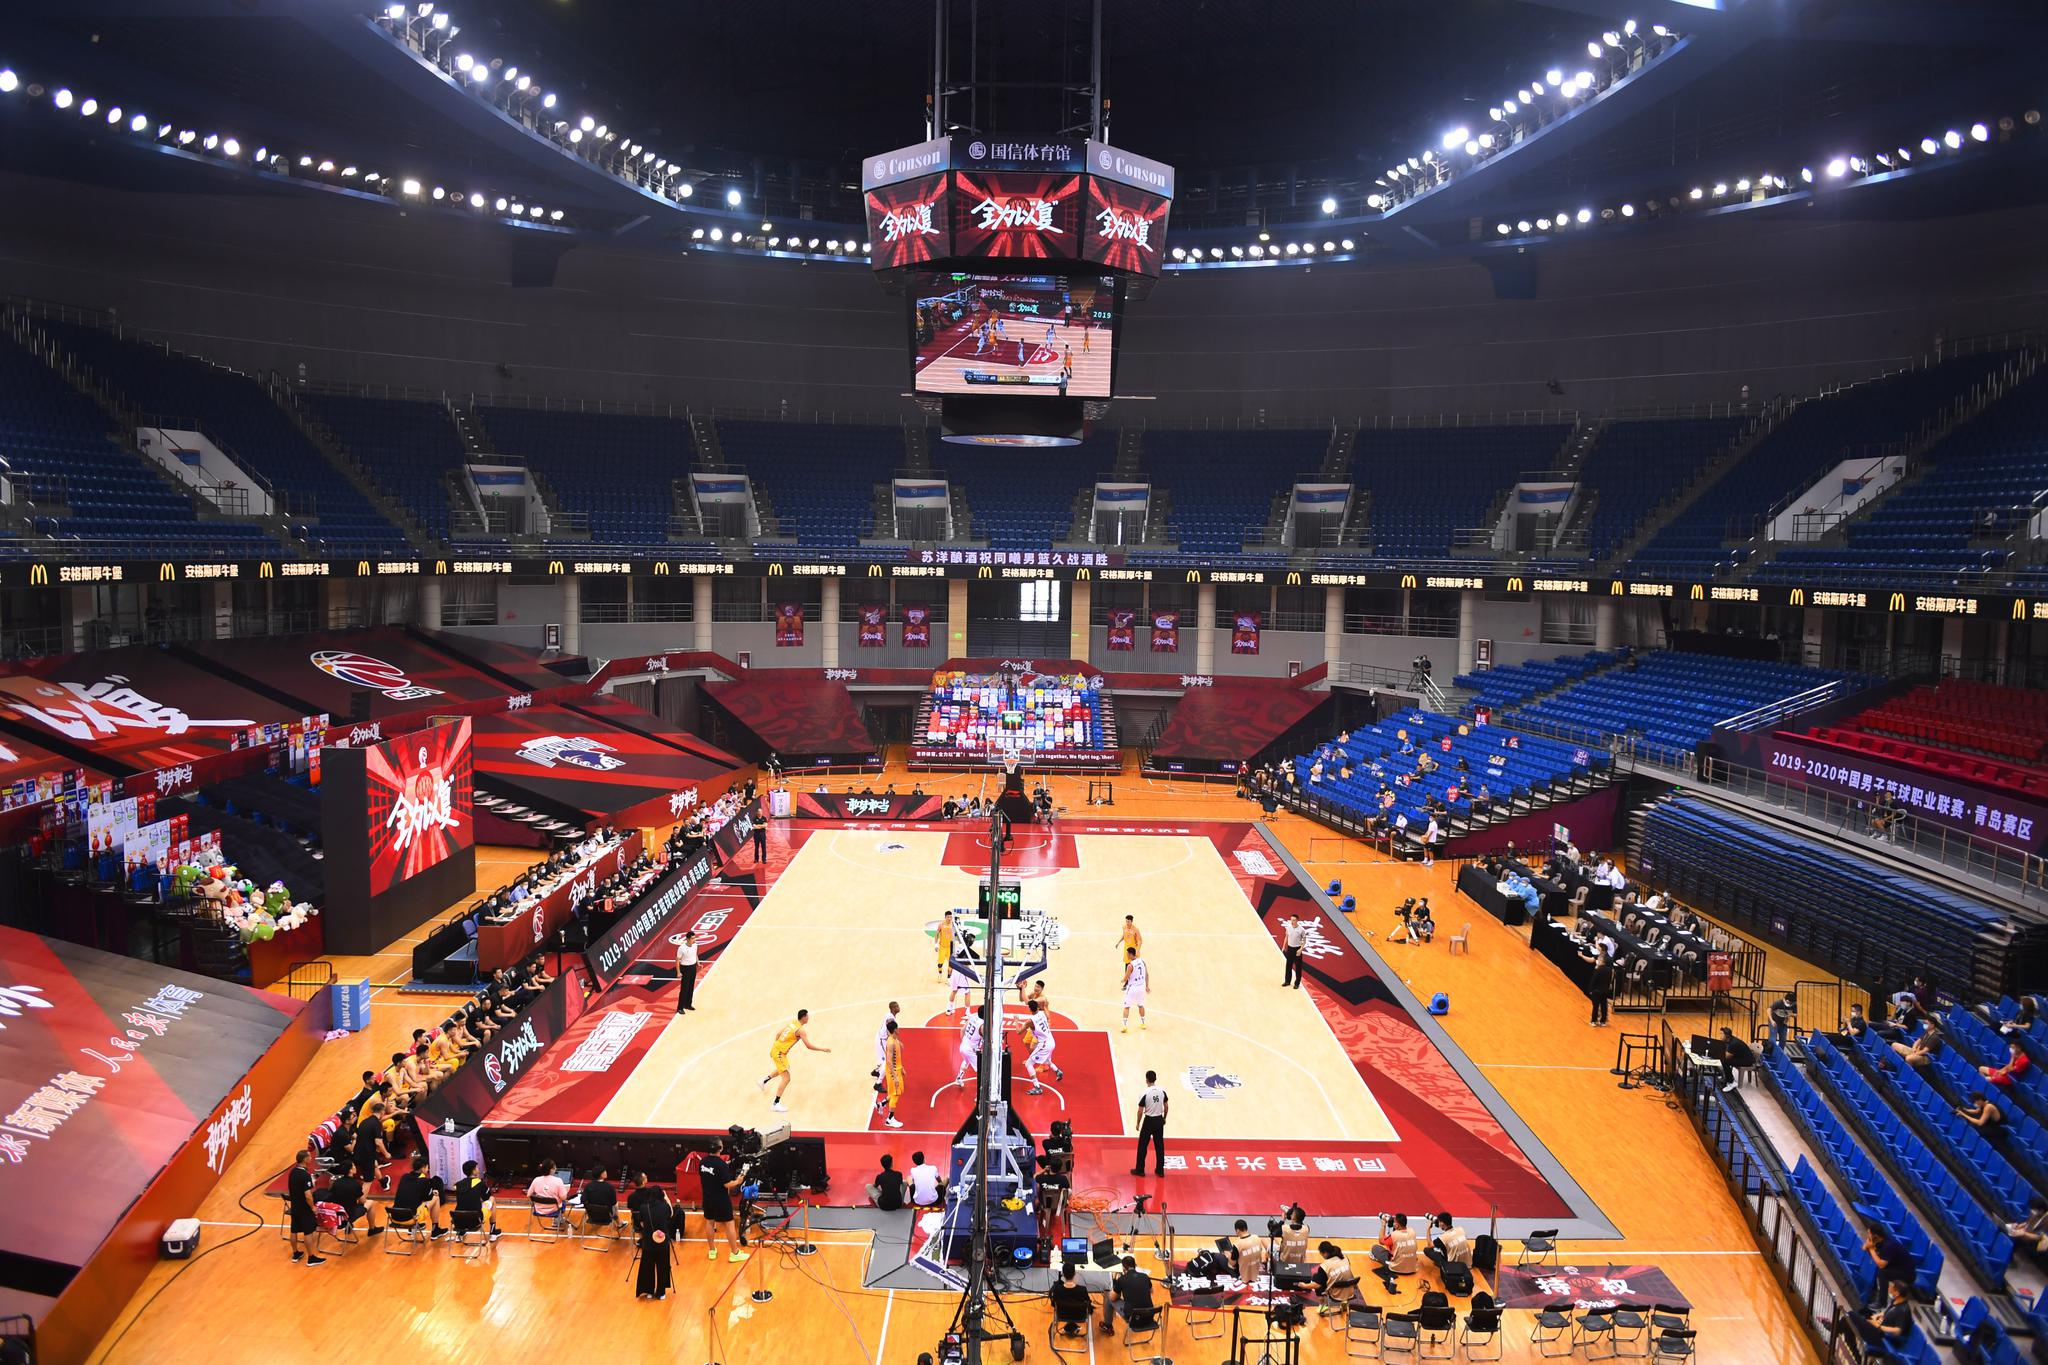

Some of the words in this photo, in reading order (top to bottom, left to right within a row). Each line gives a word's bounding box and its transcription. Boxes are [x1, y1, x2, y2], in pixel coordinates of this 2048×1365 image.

[991, 143, 1071, 162] 国信体育馆
[889, 149, 940, 175] Conson
[1115, 155, 1165, 187] Conson
[1093, 311, 1111, 319] 2019
[921, 551, 1108, 566] 苏洋酿酒祝同曦男篮久战酒胜
[59, 566, 122, 582] 安格斯厚牛堡
[185, 564, 238, 578] 安格斯厚牛堡
[282, 564, 329, 576] 安格斯厚牛堡
[377, 562, 419, 574] 安格斯厚牛堡
[453, 562, 512, 573] 安格斯厚牛堡
[574, 562, 631, 574] 安格斯厚牛堡
[679, 564, 734, 574] 安格斯厚牛堡
[792, 564, 846, 575] 安格斯厚牛堡
[892, 567, 945, 577] 安格斯厚牛堡
[1002, 568, 1054, 578] 安格斯厚牛堡
[1100, 570, 1152, 580] 安格斯厚牛堡
[1210, 572, 1264, 583] 安格斯厚牛堡
[1311, 574, 1366, 586] 安格斯厚牛堡
[1426, 577, 1483, 589] 安格斯厚牛堡
[1533, 580, 1588, 592] 安格斯厚牛堡
[1629, 583, 1673, 597] 安格斯厚牛堡
[1711, 587, 1758, 601] 安格斯厚牛堡
[1812, 592, 1866, 607] 安格斯厚牛堡
[1916, 597, 1977, 614] 安格斯厚牛堡
[154, 764, 193, 796] 敢梦敢当
[669, 787, 697, 818] 敢梦敢当
[845, 798, 890, 816] 敢梦敢当
[691, 906, 734, 933] CBA
[965, 1023, 976, 1036] 33
[5, 1071, 106, 1133] 新媒体
